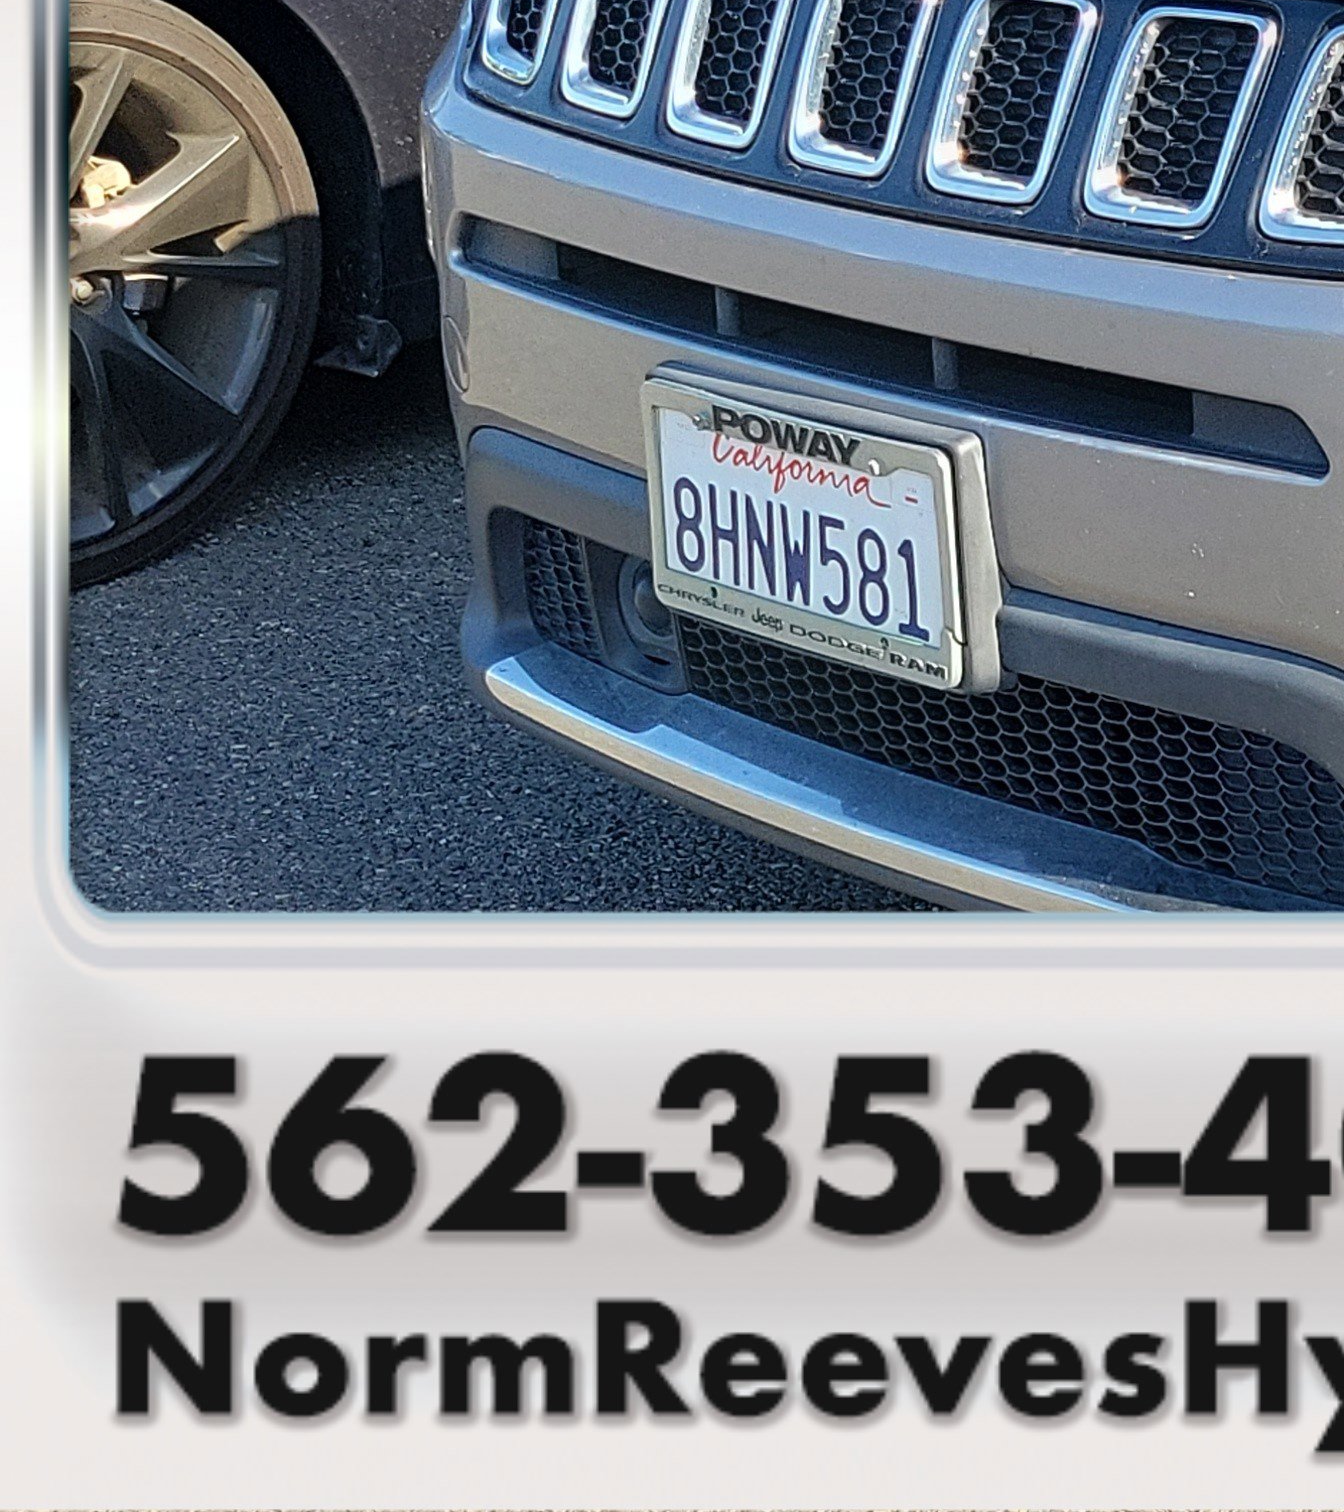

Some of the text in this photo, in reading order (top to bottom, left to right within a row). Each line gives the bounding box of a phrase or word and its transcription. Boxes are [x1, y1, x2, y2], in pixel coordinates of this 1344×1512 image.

[711, 404, 862, 466] POWAY
[672, 476, 931, 643] 8HNW581
[657, 582, 949, 681] CHRYSLER Jeep DODGE RAM
